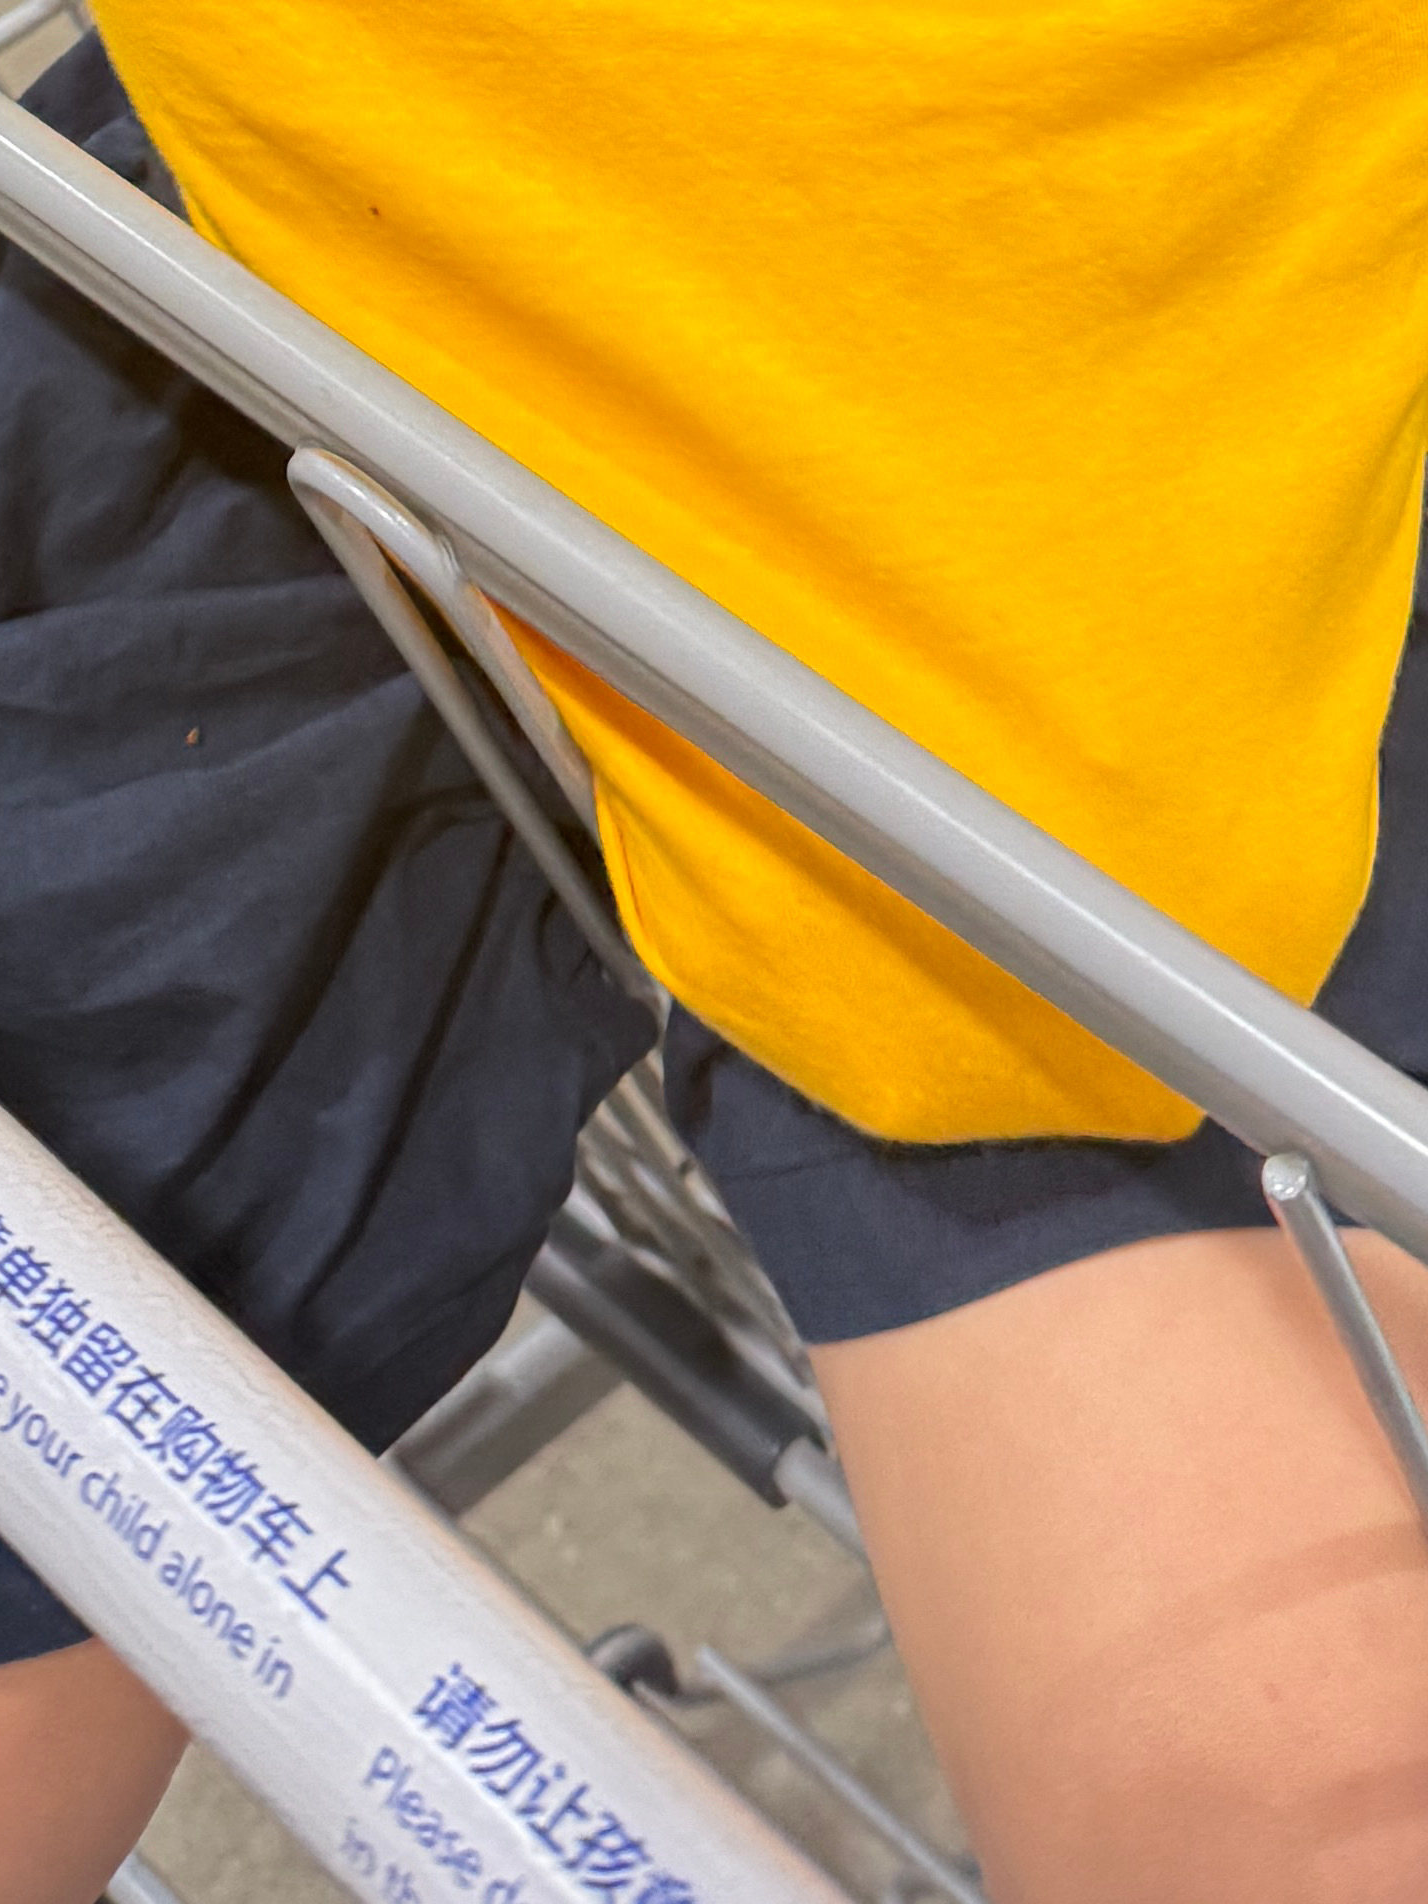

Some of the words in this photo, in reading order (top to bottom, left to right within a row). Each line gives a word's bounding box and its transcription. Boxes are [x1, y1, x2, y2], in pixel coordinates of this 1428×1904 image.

[80, 1471, 170, 1561] child
[160, 1549, 256, 1661] alone
[253, 1636, 294, 1699] in
[362, 1746, 483, 1890] Please
